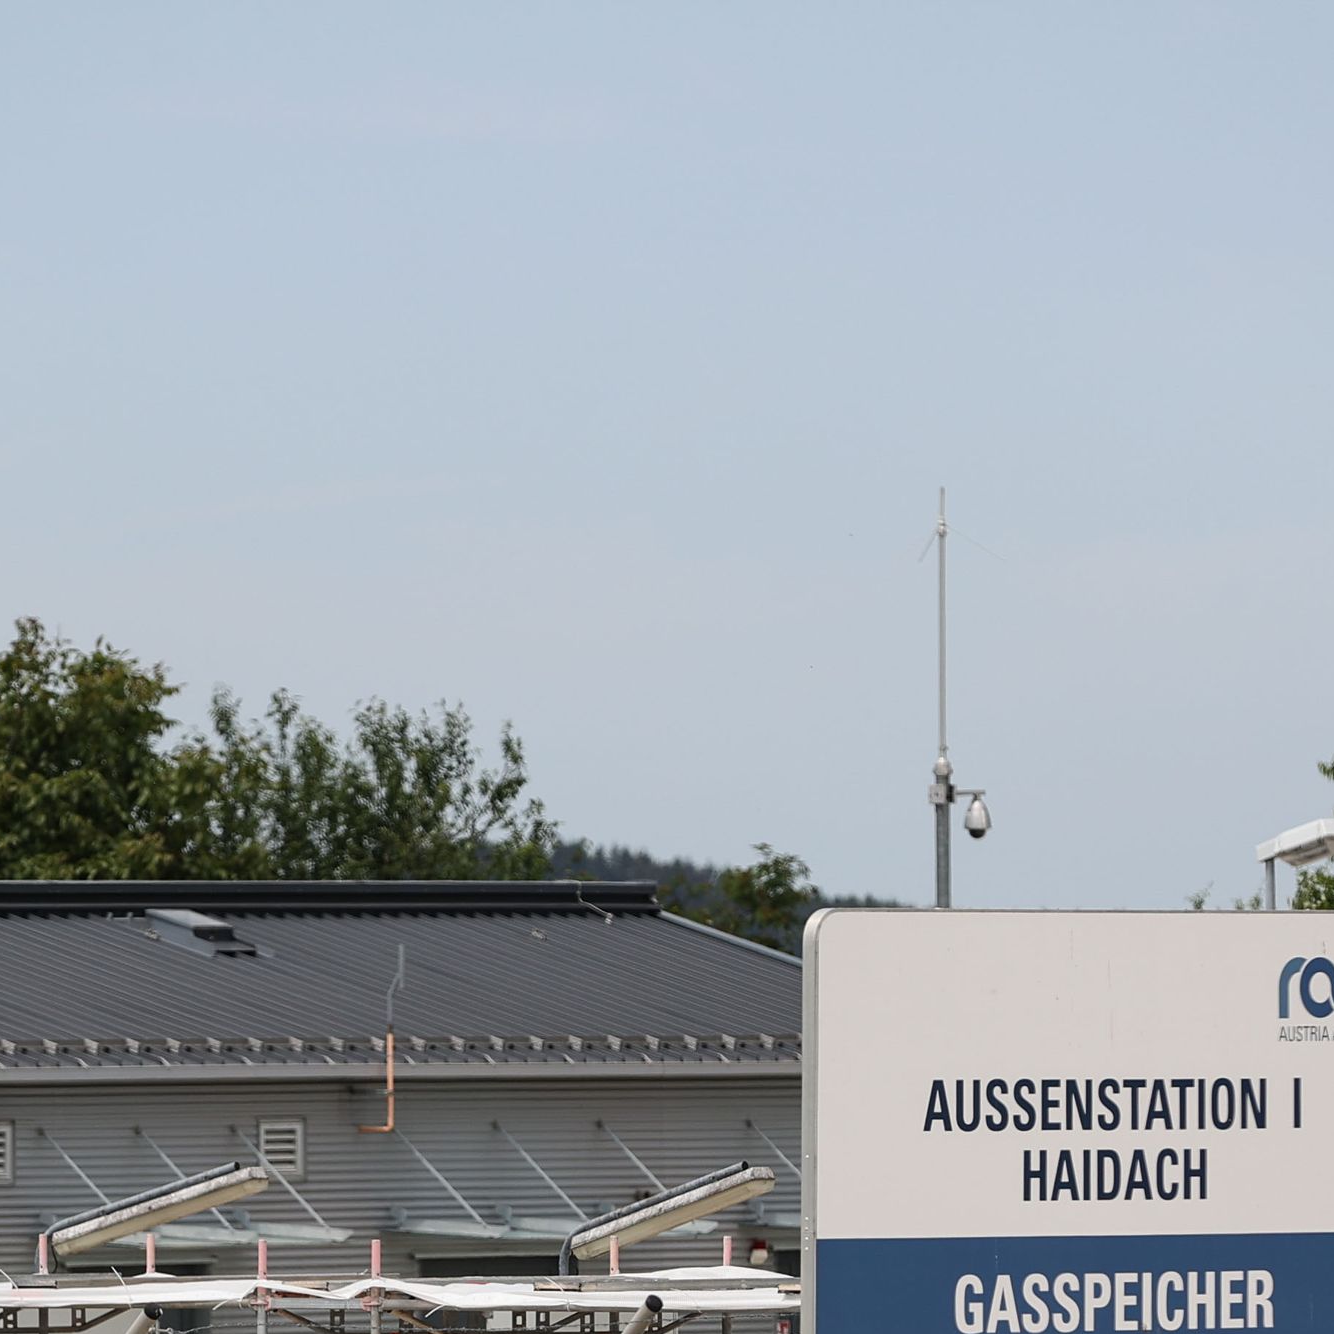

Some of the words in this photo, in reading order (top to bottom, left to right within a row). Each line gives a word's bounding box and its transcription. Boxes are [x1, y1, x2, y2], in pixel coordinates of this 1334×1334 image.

[1278, 1025, 1330, 1042] AUSTRIA
[923, 1078, 1267, 1132] AUSSENSTATION
[1293, 1077, 1302, 1129] I
[1022, 1148, 1208, 1201] HAIDACH
[954, 1269, 1274, 1334] GASSPEICHER
